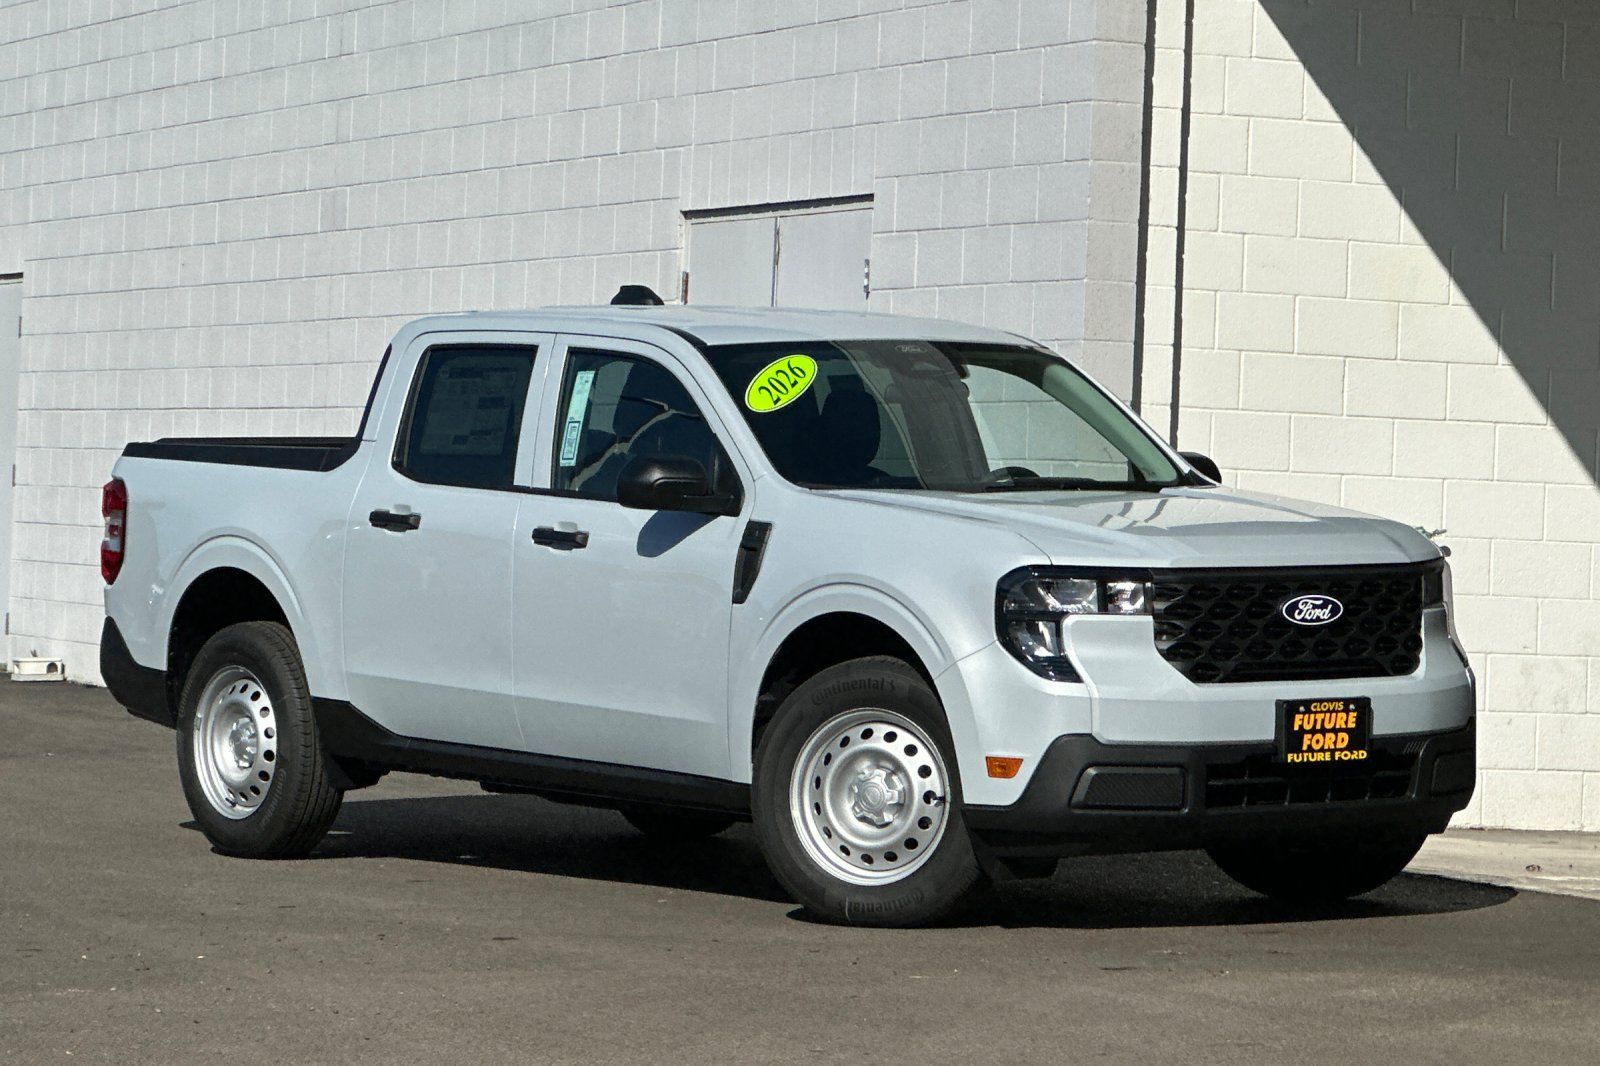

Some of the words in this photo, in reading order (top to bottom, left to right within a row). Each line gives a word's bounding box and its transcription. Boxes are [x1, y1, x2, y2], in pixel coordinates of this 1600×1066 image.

[757, 359, 807, 406] 2026
[1294, 598, 1333, 620] Ford
[811, 677, 885, 706] Continental
[1310, 701, 1344, 712] CLOVIS
[1293, 711, 1358, 731] FUTURE
[1301, 732, 1349, 751] FORD
[1287, 752, 1331, 763] FUTURE
[1335, 750, 1368, 760] FORD
